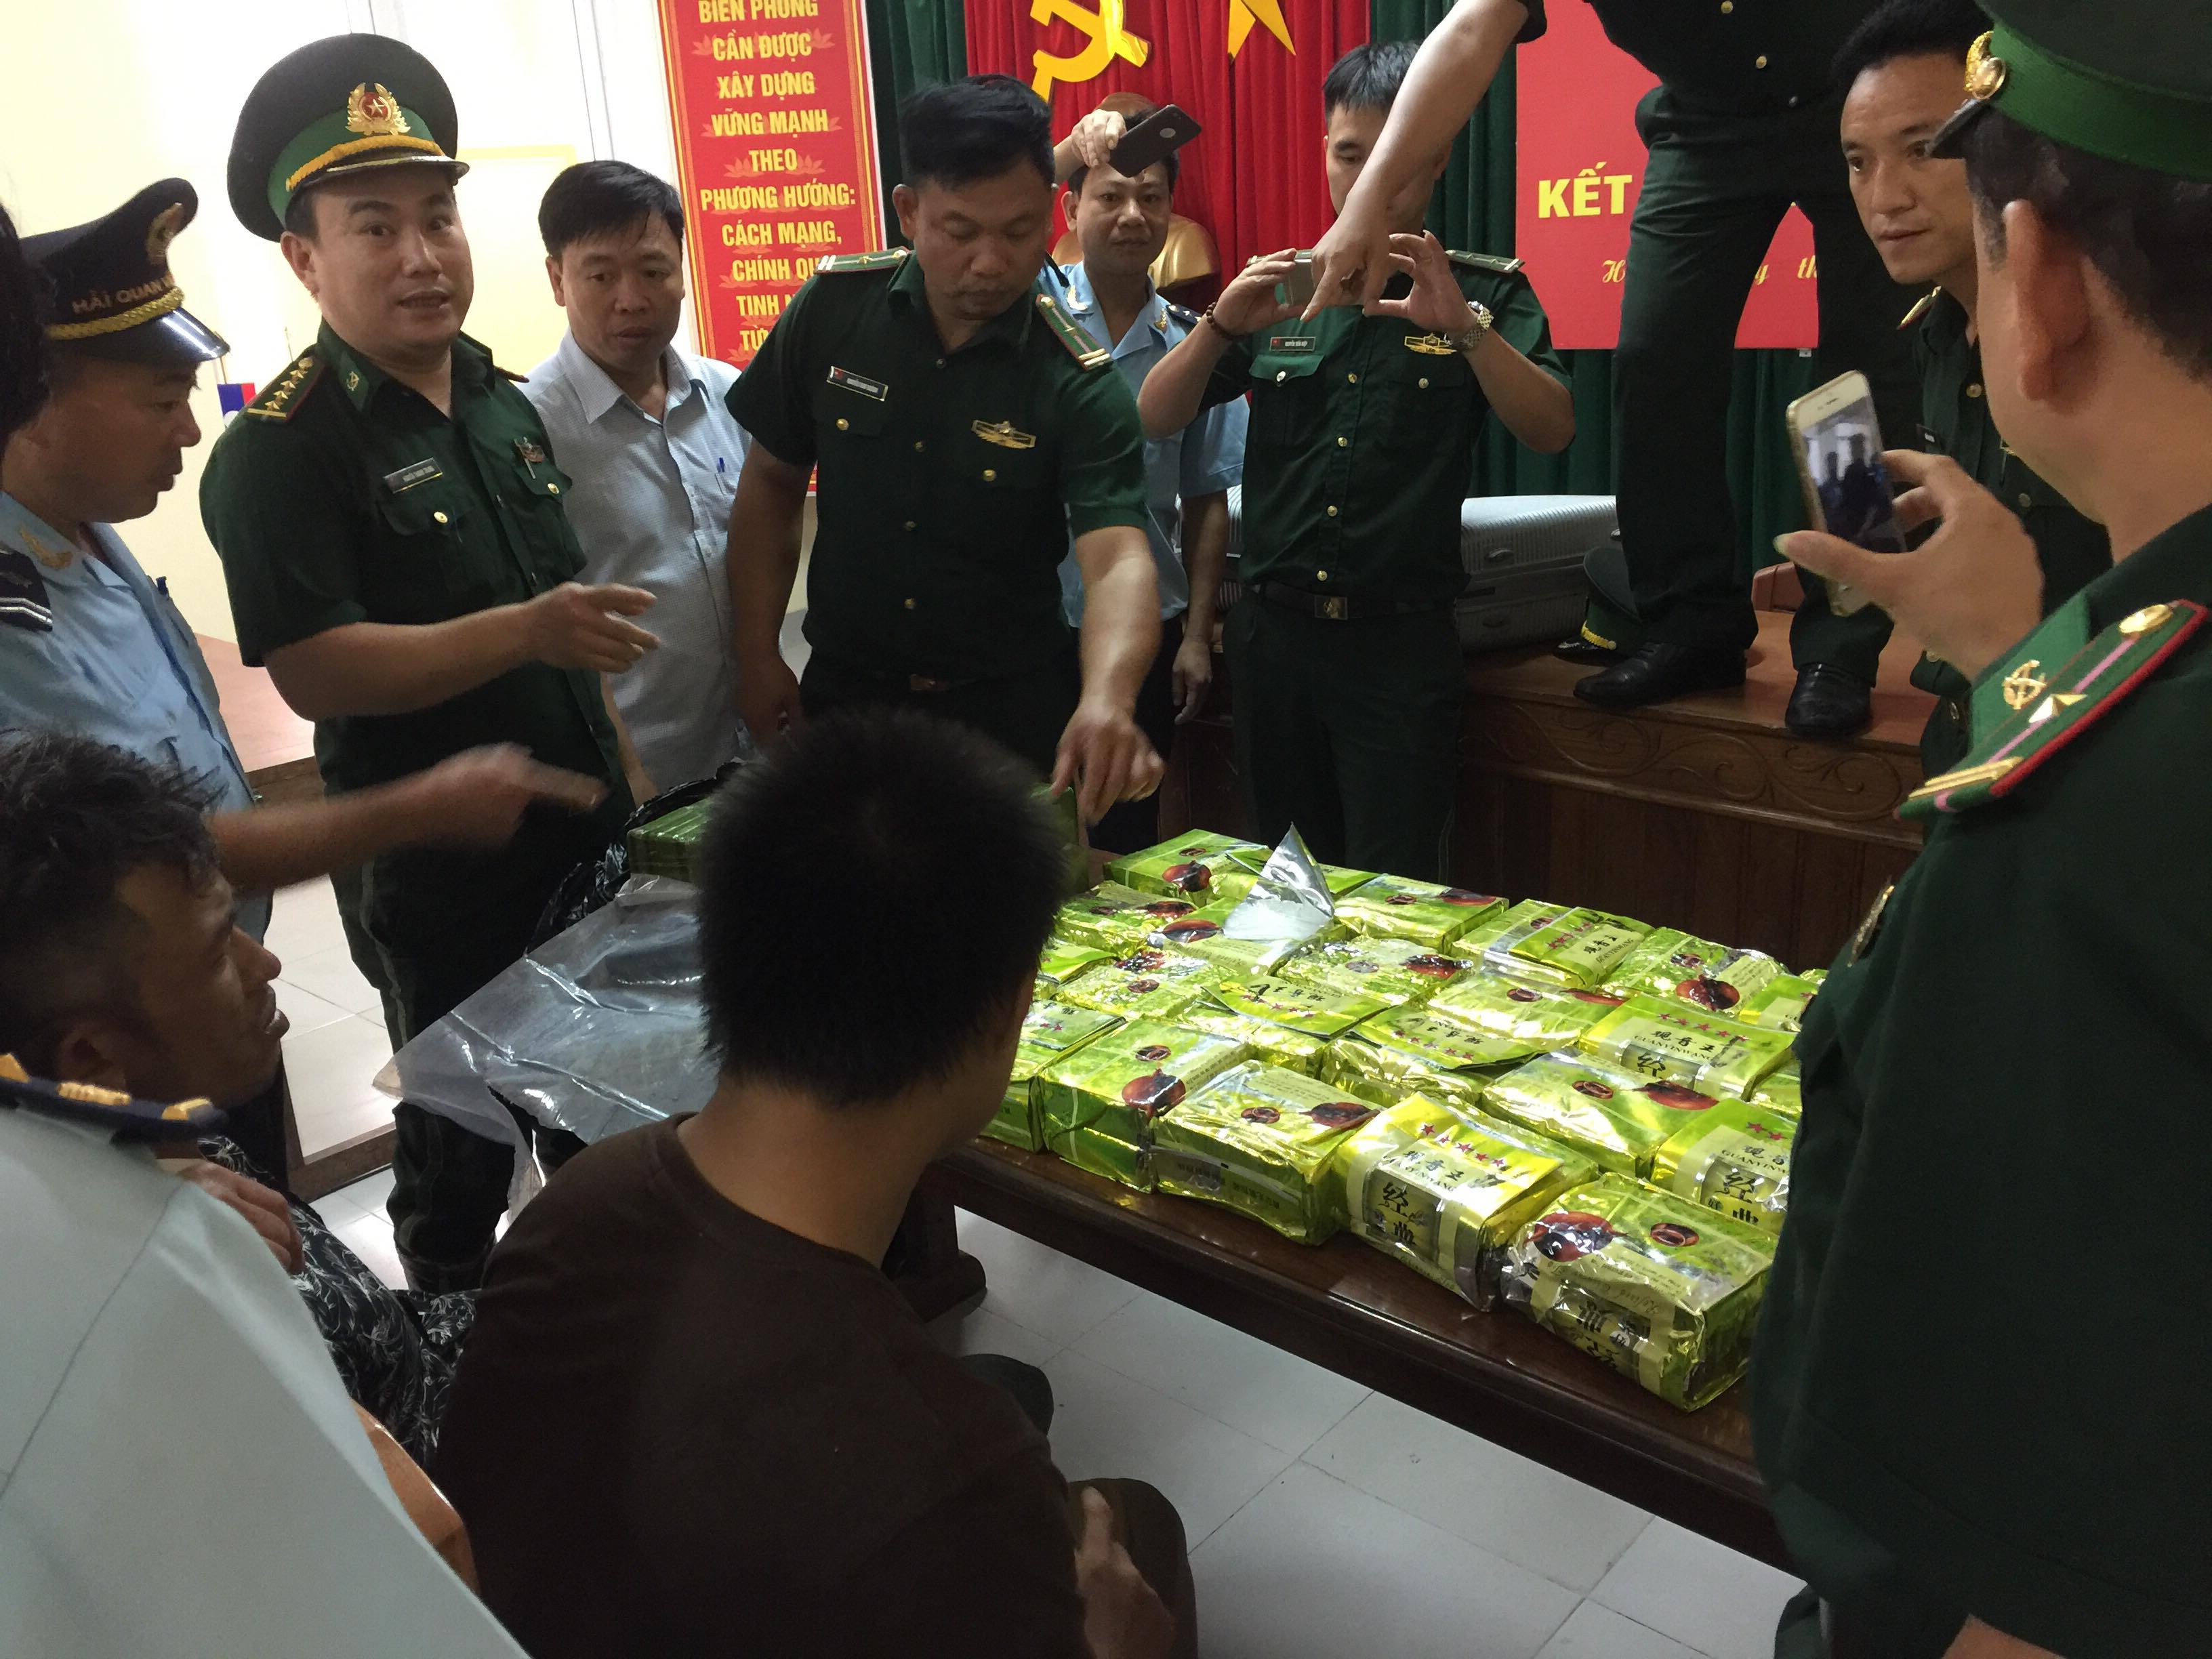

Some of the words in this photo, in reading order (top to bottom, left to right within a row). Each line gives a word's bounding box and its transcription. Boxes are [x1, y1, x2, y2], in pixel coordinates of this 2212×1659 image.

[713, 29, 754, 61] CẦN
[758, 32, 812, 62] ĐƯỢC
[717, 70, 754, 99] XÂY
[760, 70, 815, 100] DỰNG
[711, 108, 764, 137] VỮNG
[769, 109, 828, 138] MẠNH
[749, 148, 798, 172] THEO
[700, 186, 779, 211] PHƯƠNG
[783, 178, 856, 207] HƯỚNG:
[1538, 161, 1633, 218] KẾT
[722, 219, 773, 247] CÁCH
[778, 220, 842, 249] MẠNG,
[733, 255, 791, 282] CHÍNH
[795, 258, 819, 281] QU
[736, 294, 780, 316] TINH
[740, 325, 769, 351] TỪ
